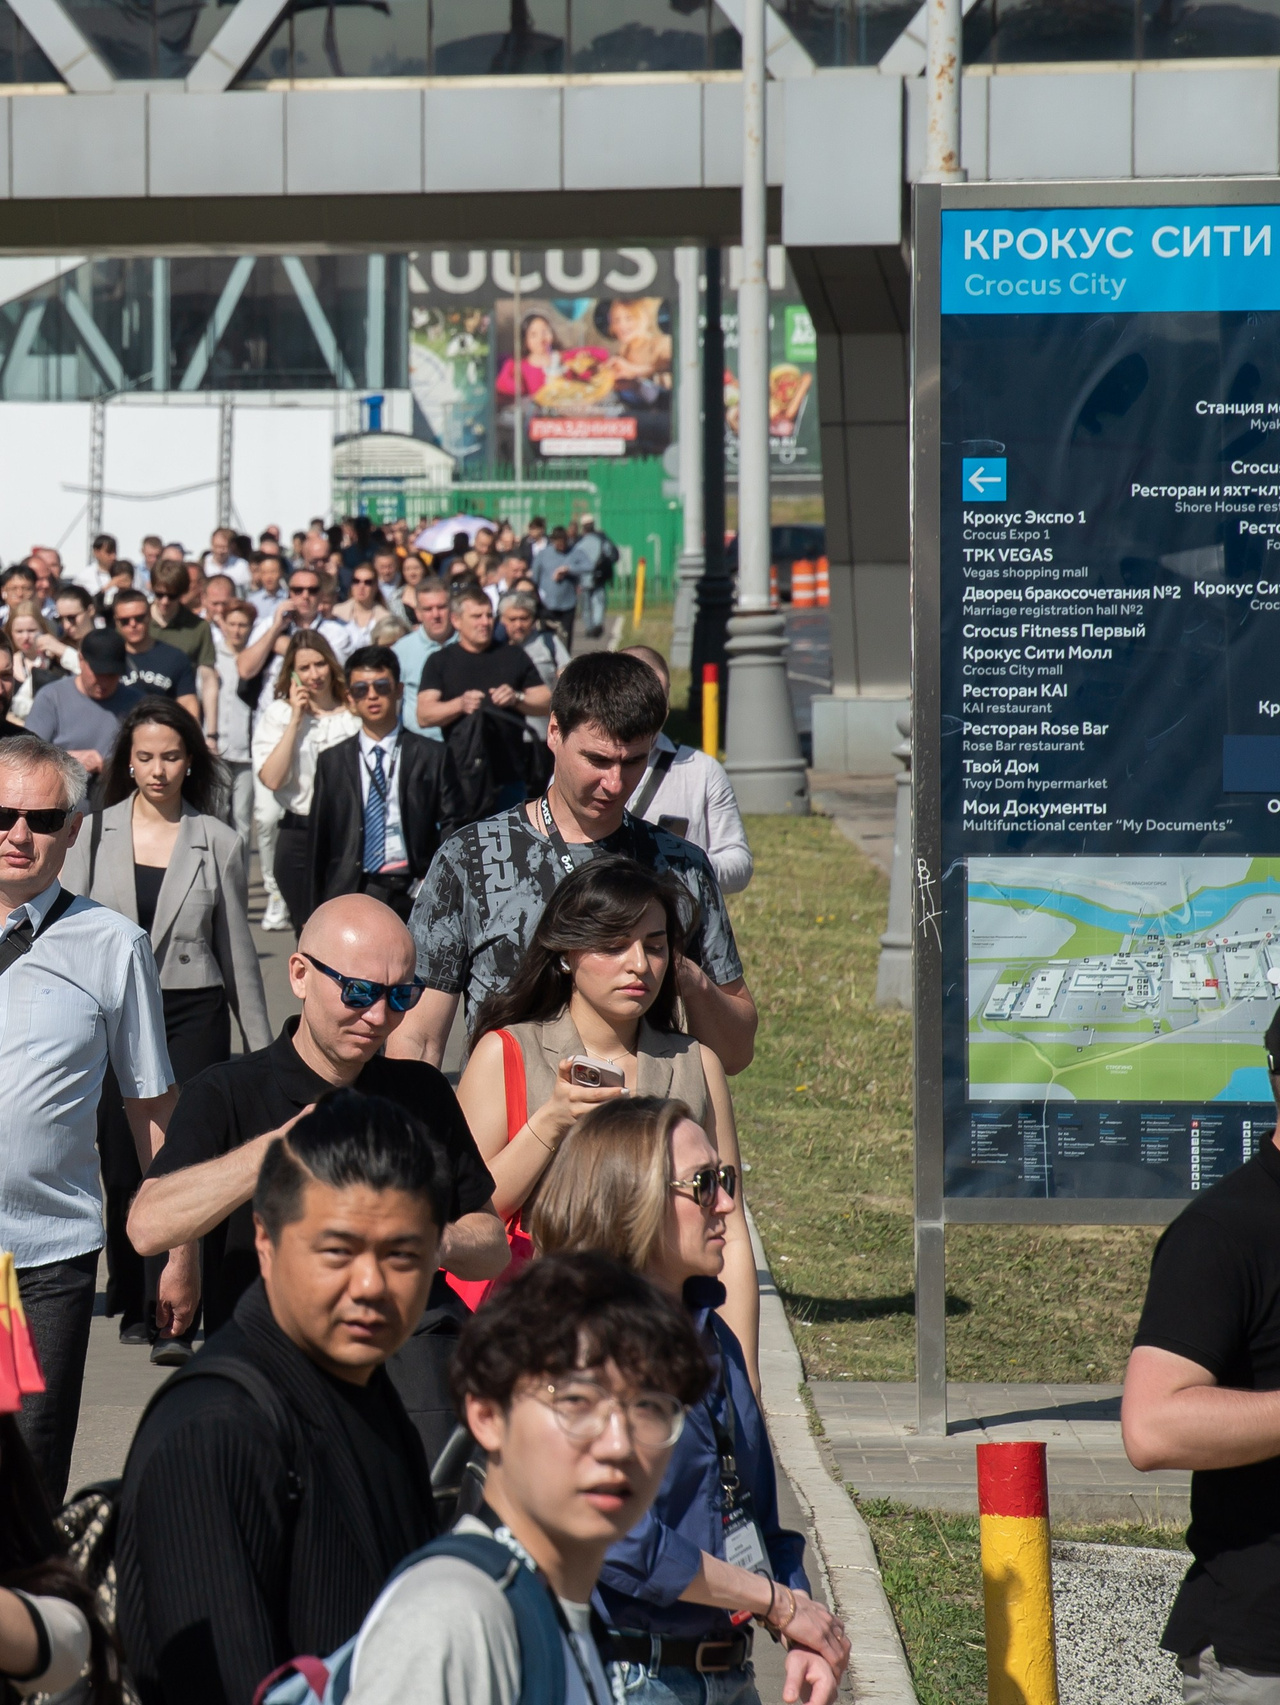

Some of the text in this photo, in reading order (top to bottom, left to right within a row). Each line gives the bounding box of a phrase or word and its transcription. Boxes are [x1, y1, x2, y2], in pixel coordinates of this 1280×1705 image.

[965, 225, 1271, 260] КРОКУС СИТИ
[408, 247, 658, 294] OCUS
[965, 273, 1126, 300] Crocus City
[1196, 401, 1280, 415] Станция м
[1231, 460, 1280, 475] Crocu
[1132, 484, 1280, 500] Ресторан и яхт-кл
[1175, 502, 1212, 512] Shore
[1215, 501, 1255, 512] House
[964, 510, 1086, 527] Крокус Экспо 1
[963, 529, 1050, 542] Crocus Expo 1
[963, 548, 1053, 561] ТРК VEGAS
[963, 567, 1088, 580] Vegas shopping mall
[963, 586, 1181, 603] Дворец бракосочетания №2
[1194, 581, 1280, 598] Крокус Си
[963, 604, 1143, 618] Marriage registration hall №2
[963, 624, 1145, 640] Crocus Fitness Первый
[963, 646, 1112, 662] Крокус Сити Молл
[963, 664, 1062, 678] Crocus City mall
[963, 684, 1067, 700] Ресторан KAI
[963, 703, 1052, 713] KAI restaurant
[963, 722, 1109, 738] Ресторан Rose Bar
[963, 740, 1084, 751] Rose Bar restaurant
[963, 760, 1038, 775] Твой Дом
[963, 778, 1107, 791] Tvoy Dom hypermarket
[963, 800, 1106, 818] Мои Документы
[963, 819, 1065, 831] Multifunctional
[1068, 820, 1112, 831] center
